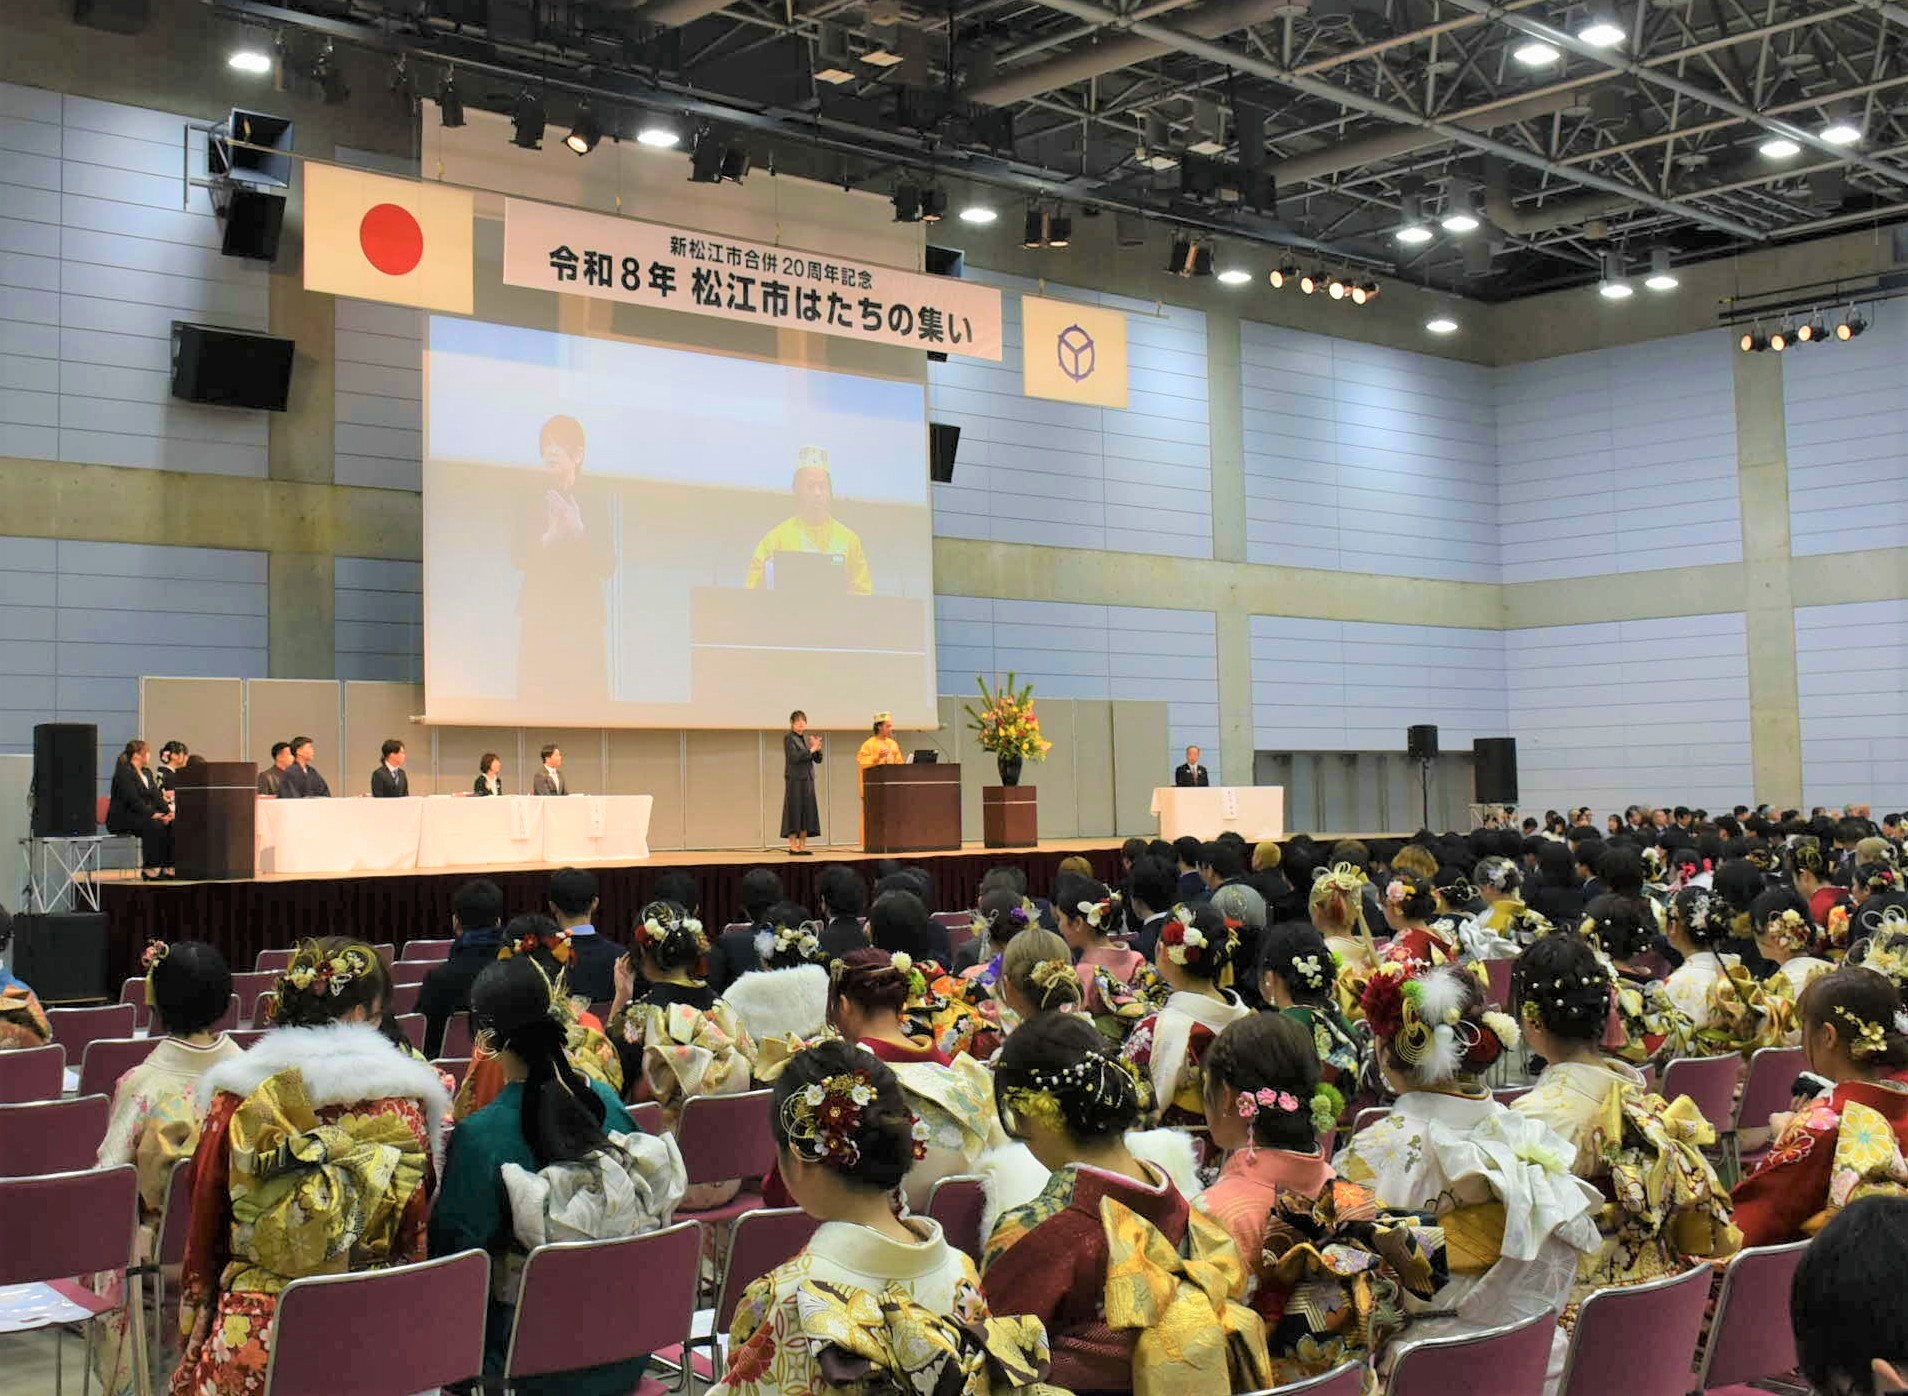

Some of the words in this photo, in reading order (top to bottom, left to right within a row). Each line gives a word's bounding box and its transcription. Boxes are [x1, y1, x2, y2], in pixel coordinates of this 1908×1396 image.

[549, 245, 677, 297] 令和8年
[692, 267, 972, 344] 松江市はたちの集い
[670, 236, 873, 290] 新松江市合併20周年記念
